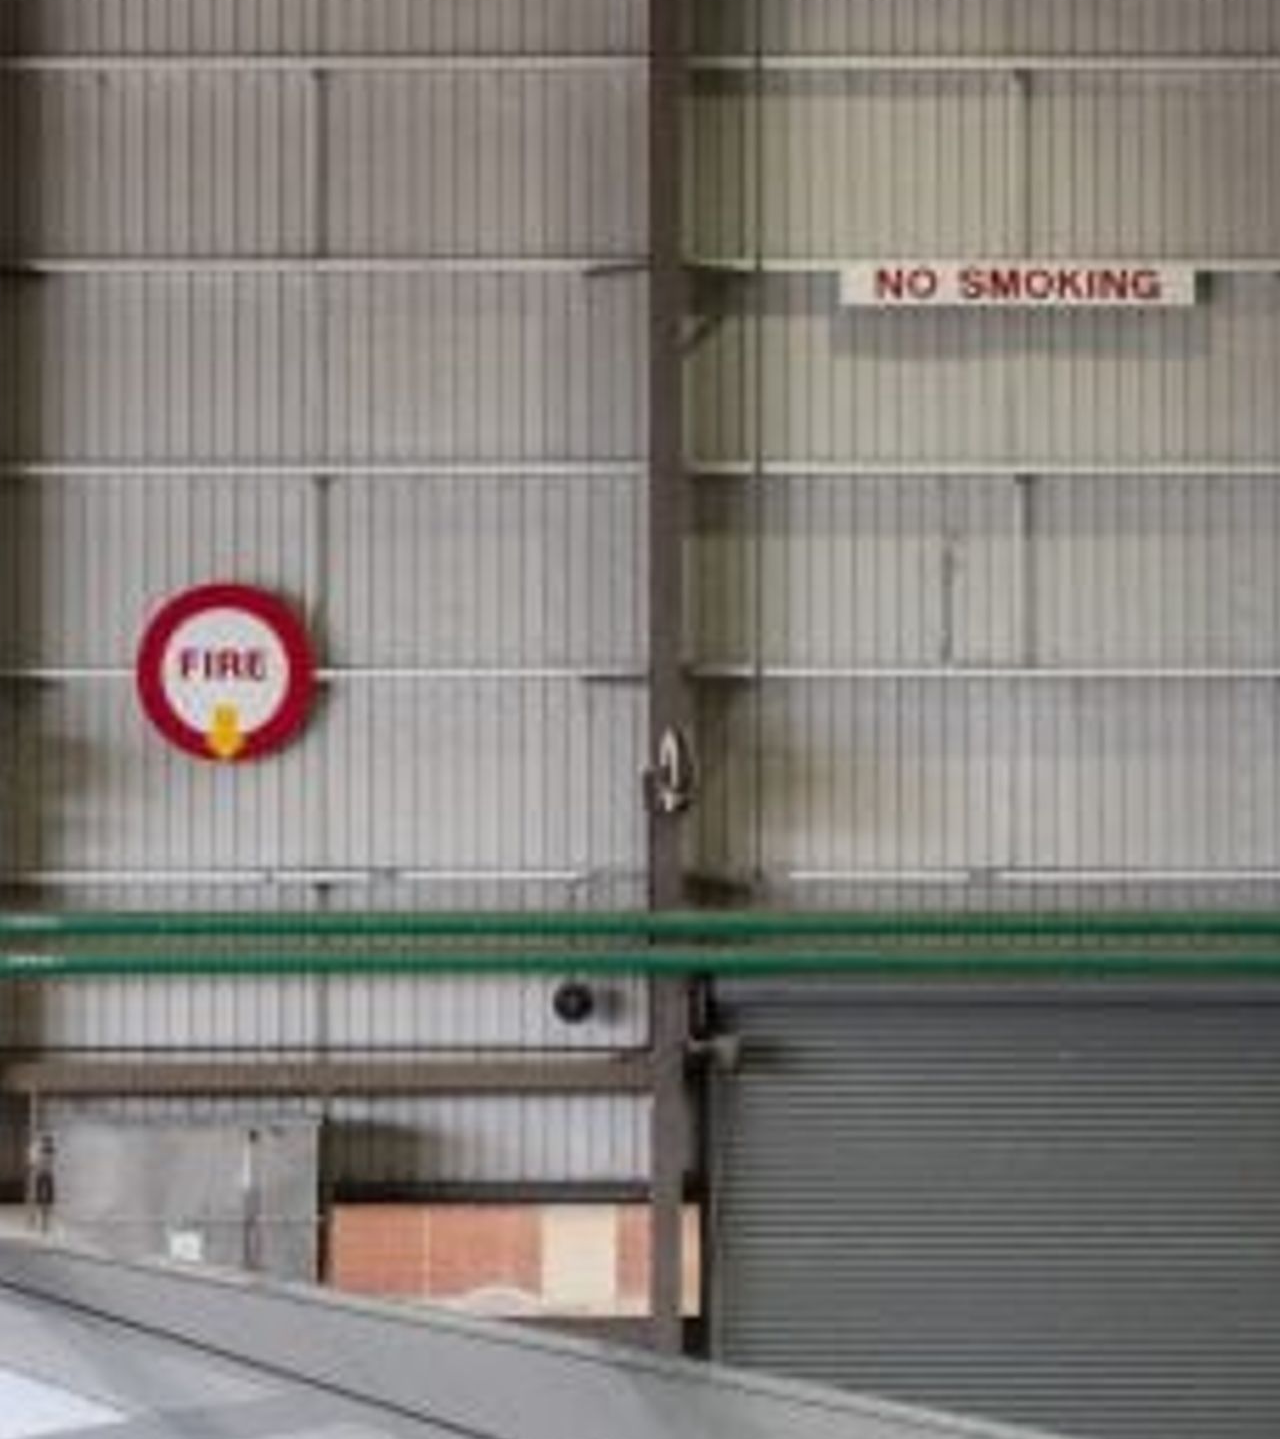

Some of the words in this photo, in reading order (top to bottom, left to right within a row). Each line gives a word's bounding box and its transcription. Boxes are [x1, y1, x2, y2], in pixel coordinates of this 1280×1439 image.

[875, 269, 938, 300] NO
[957, 269, 1162, 300] SMOKING
[180, 647, 266, 681] FIRE
